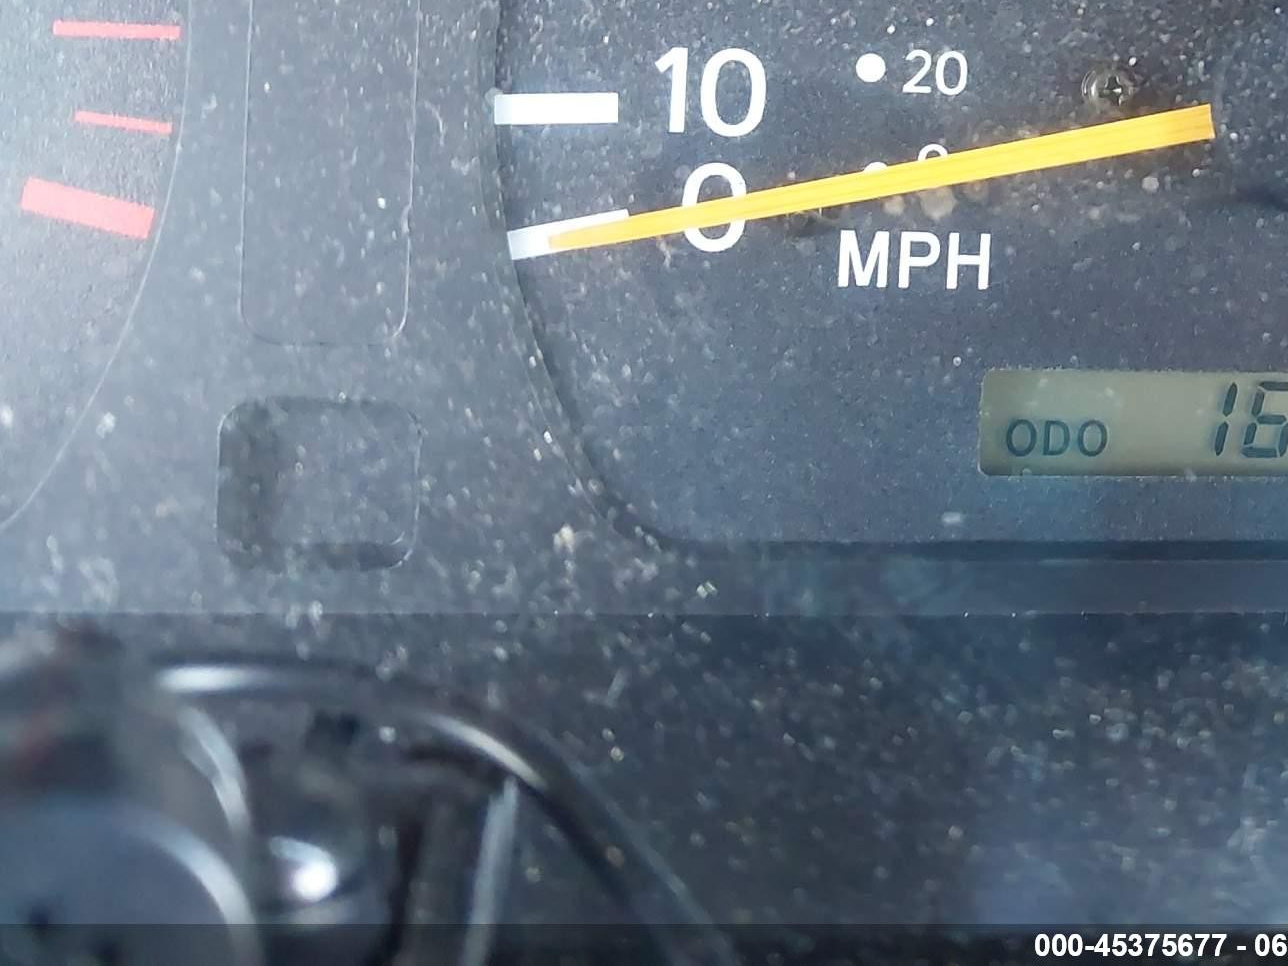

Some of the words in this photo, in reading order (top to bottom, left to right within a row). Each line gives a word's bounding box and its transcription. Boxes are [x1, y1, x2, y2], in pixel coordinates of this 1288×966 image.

[655, 47, 766, 137] 10
[903, 48, 967, 95] 20
[682, 162, 747, 252] 0
[838, 230, 991, 290] MPH
[1004, 418, 1109, 458] ODO
